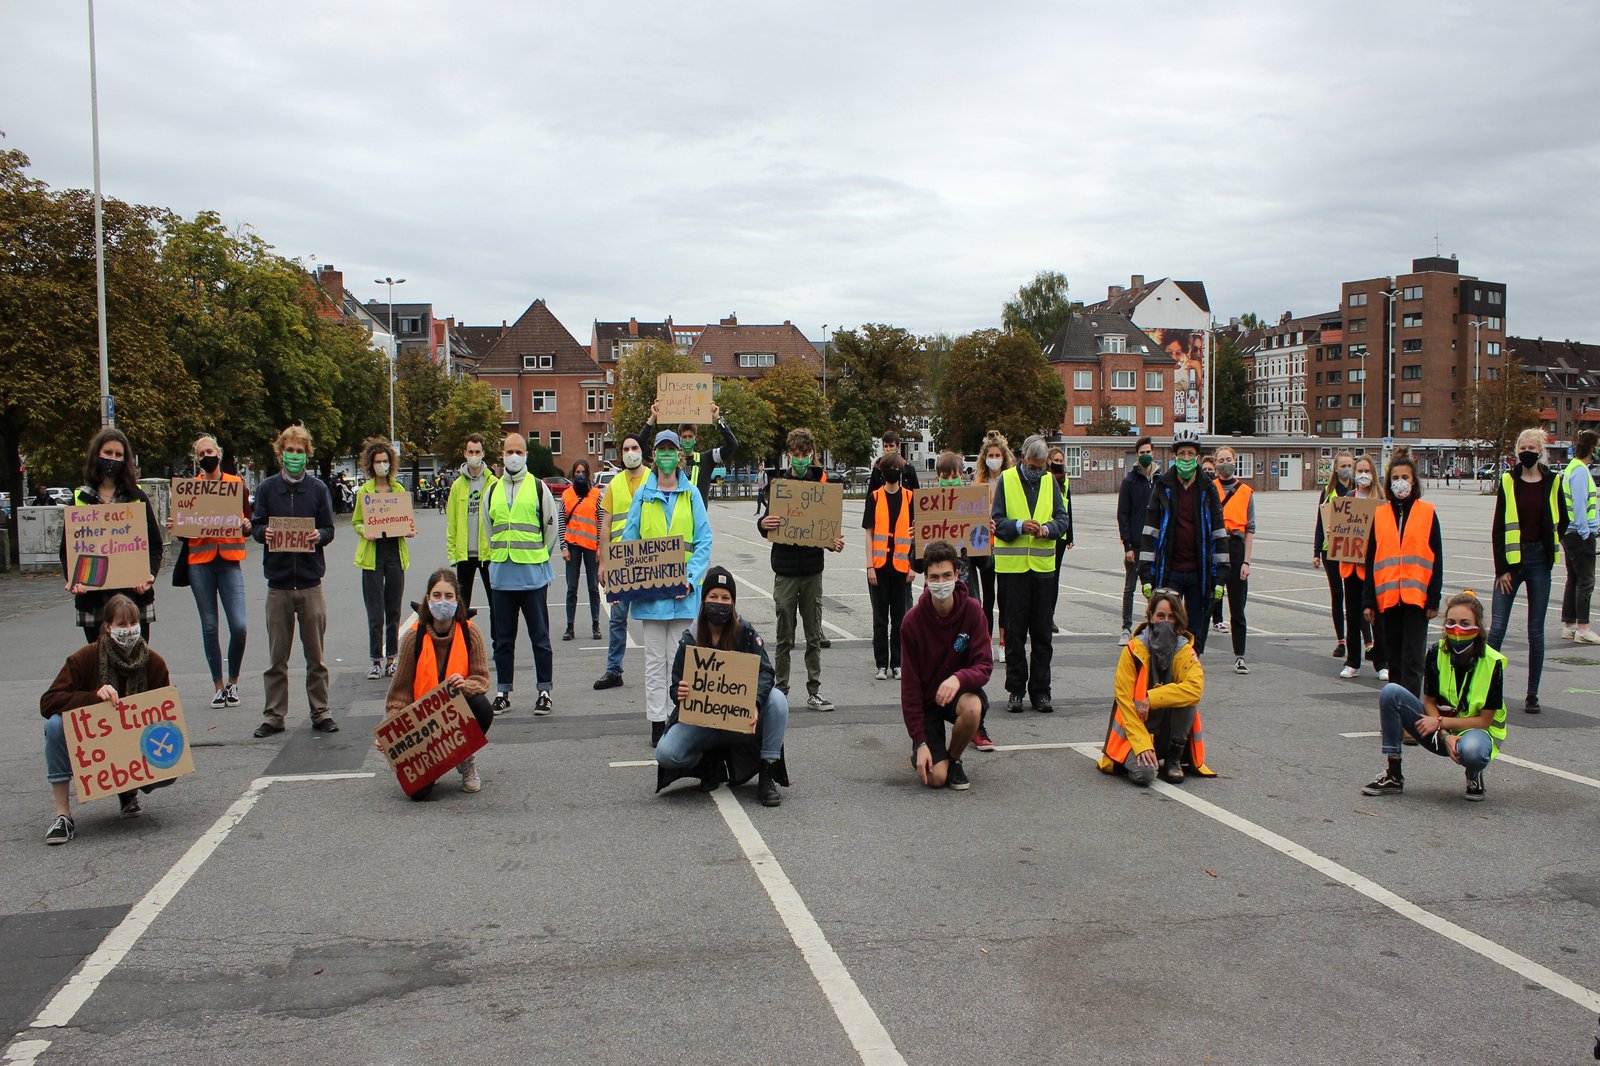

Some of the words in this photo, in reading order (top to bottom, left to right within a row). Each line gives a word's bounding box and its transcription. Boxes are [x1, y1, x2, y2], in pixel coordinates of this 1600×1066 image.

[659, 376, 694, 392] Unsere
[660, 393, 691, 406] Zukunft
[690, 406, 701, 416] mit
[176, 480, 238, 496] GRENZEN
[775, 484, 793, 499] Es
[800, 486, 826, 510] gibt
[177, 496, 196, 510] auf
[364, 494, 382, 505] Oma
[919, 487, 959, 512] exit
[957, 495, 987, 516] coal
[1332, 499, 1352, 515] WE
[71, 509, 99, 522] Fuck
[104, 505, 134, 521] each
[176, 510, 241, 527] Emissionen
[786, 502, 804, 518] kein
[1346, 512, 1369, 525] didn't
[74, 525, 106, 539] other
[111, 522, 132, 535] not
[200, 526, 240, 537] runter
[776, 516, 815, 540] Planet
[921, 518, 970, 540] enter
[1332, 523, 1351, 534] start
[1352, 526, 1364, 537] the
[74, 539, 95, 553] the
[100, 535, 148, 555] climate
[271, 531, 283, 549] NO
[608, 544, 634, 560] KEIN
[639, 538, 680, 556] MENSCH
[1331, 536, 1367, 560] FIR
[624, 554, 659, 567] BRAUCHT
[607, 562, 685, 587] KREUZFAHRTEN
[693, 648, 725, 671] Wir
[692, 671, 747, 695] bleiben
[377, 711, 416, 744] THE
[412, 681, 461, 722] WRONG
[683, 695, 752, 721] unbequem.
[71, 708, 113, 743] Its
[115, 700, 177, 730] time
[388, 718, 440, 760] amazon
[441, 704, 458, 725] IS
[75, 746, 106, 768] to
[402, 729, 467, 783] BURNING
[80, 755, 155, 796] rebel
